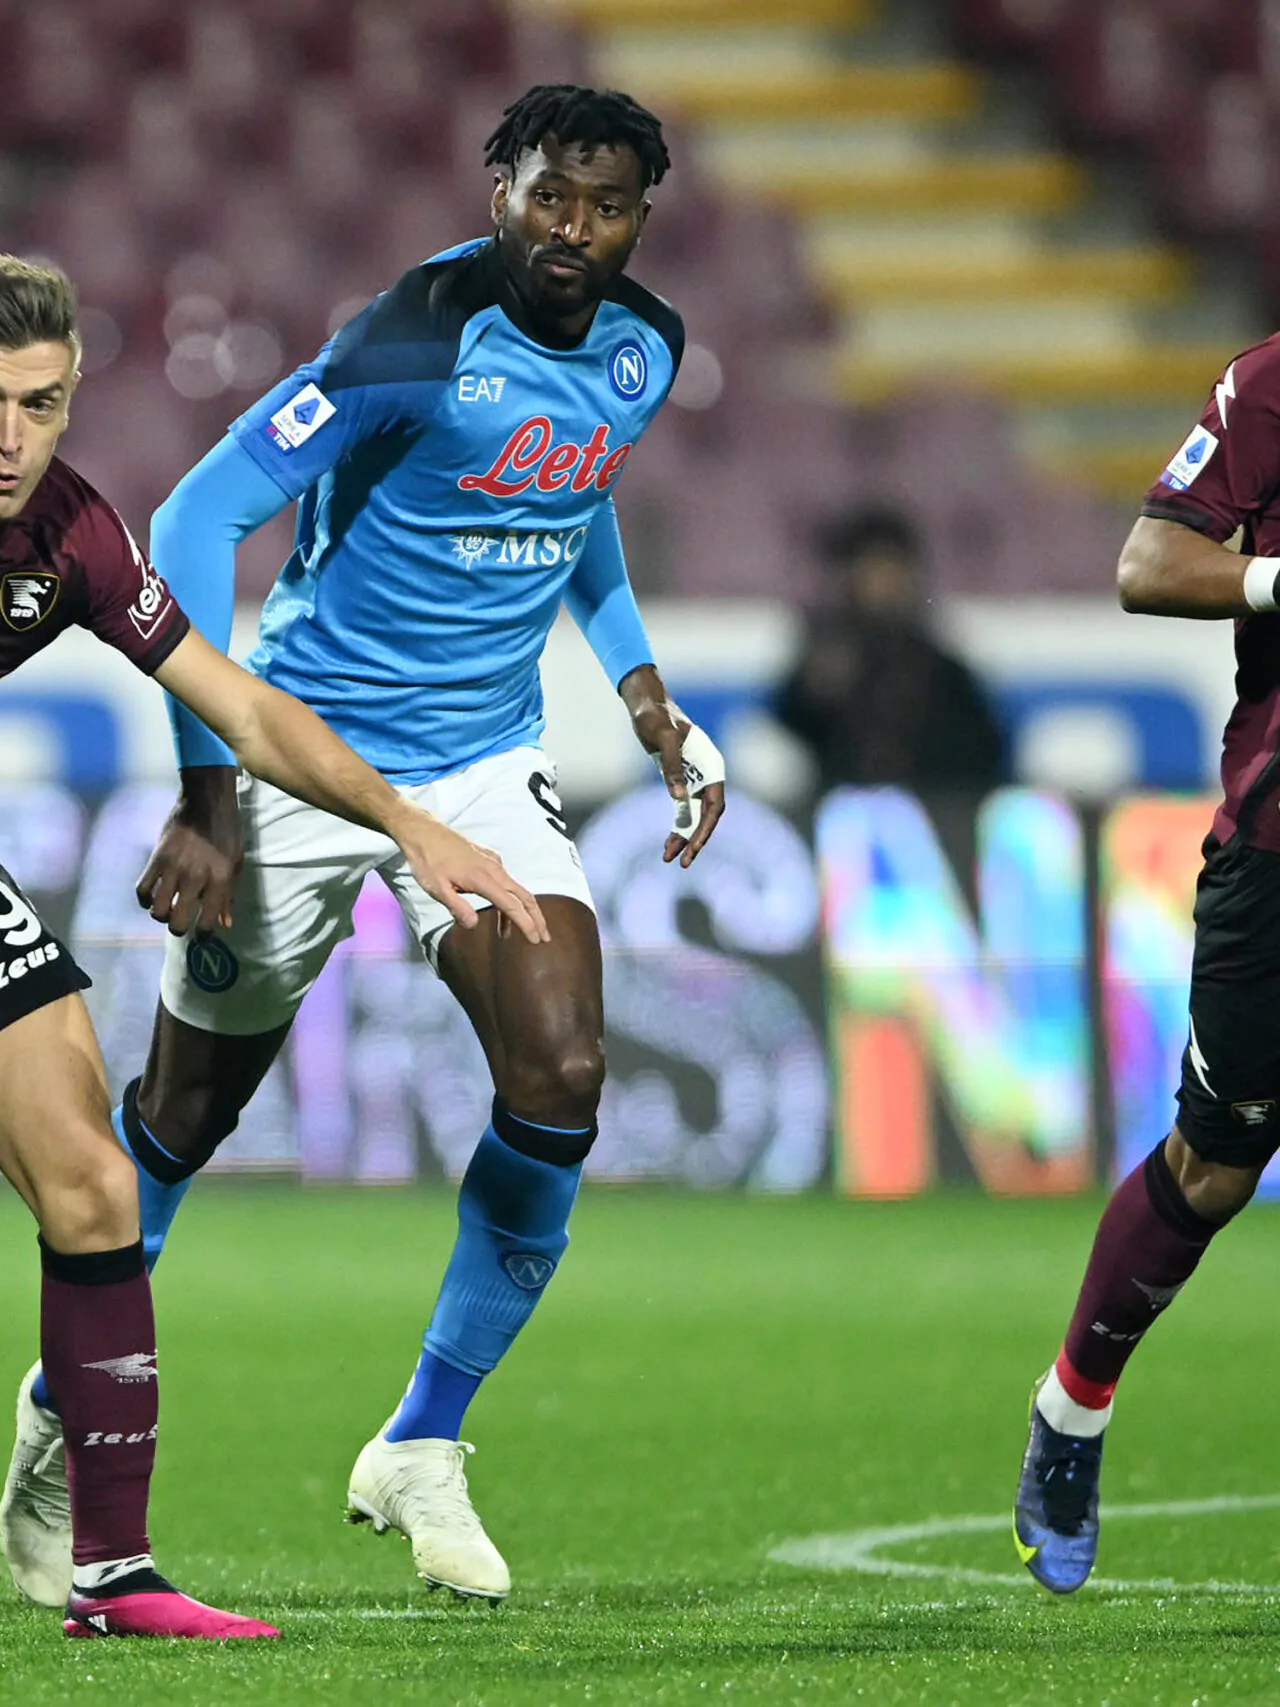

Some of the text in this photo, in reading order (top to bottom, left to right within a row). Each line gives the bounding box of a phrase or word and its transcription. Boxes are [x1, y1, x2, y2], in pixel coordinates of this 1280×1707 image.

[619, 354, 639, 385] N
[458, 376, 506, 402] EA7
[457, 415, 633, 497] Lete
[495, 525, 588, 566] MSC
